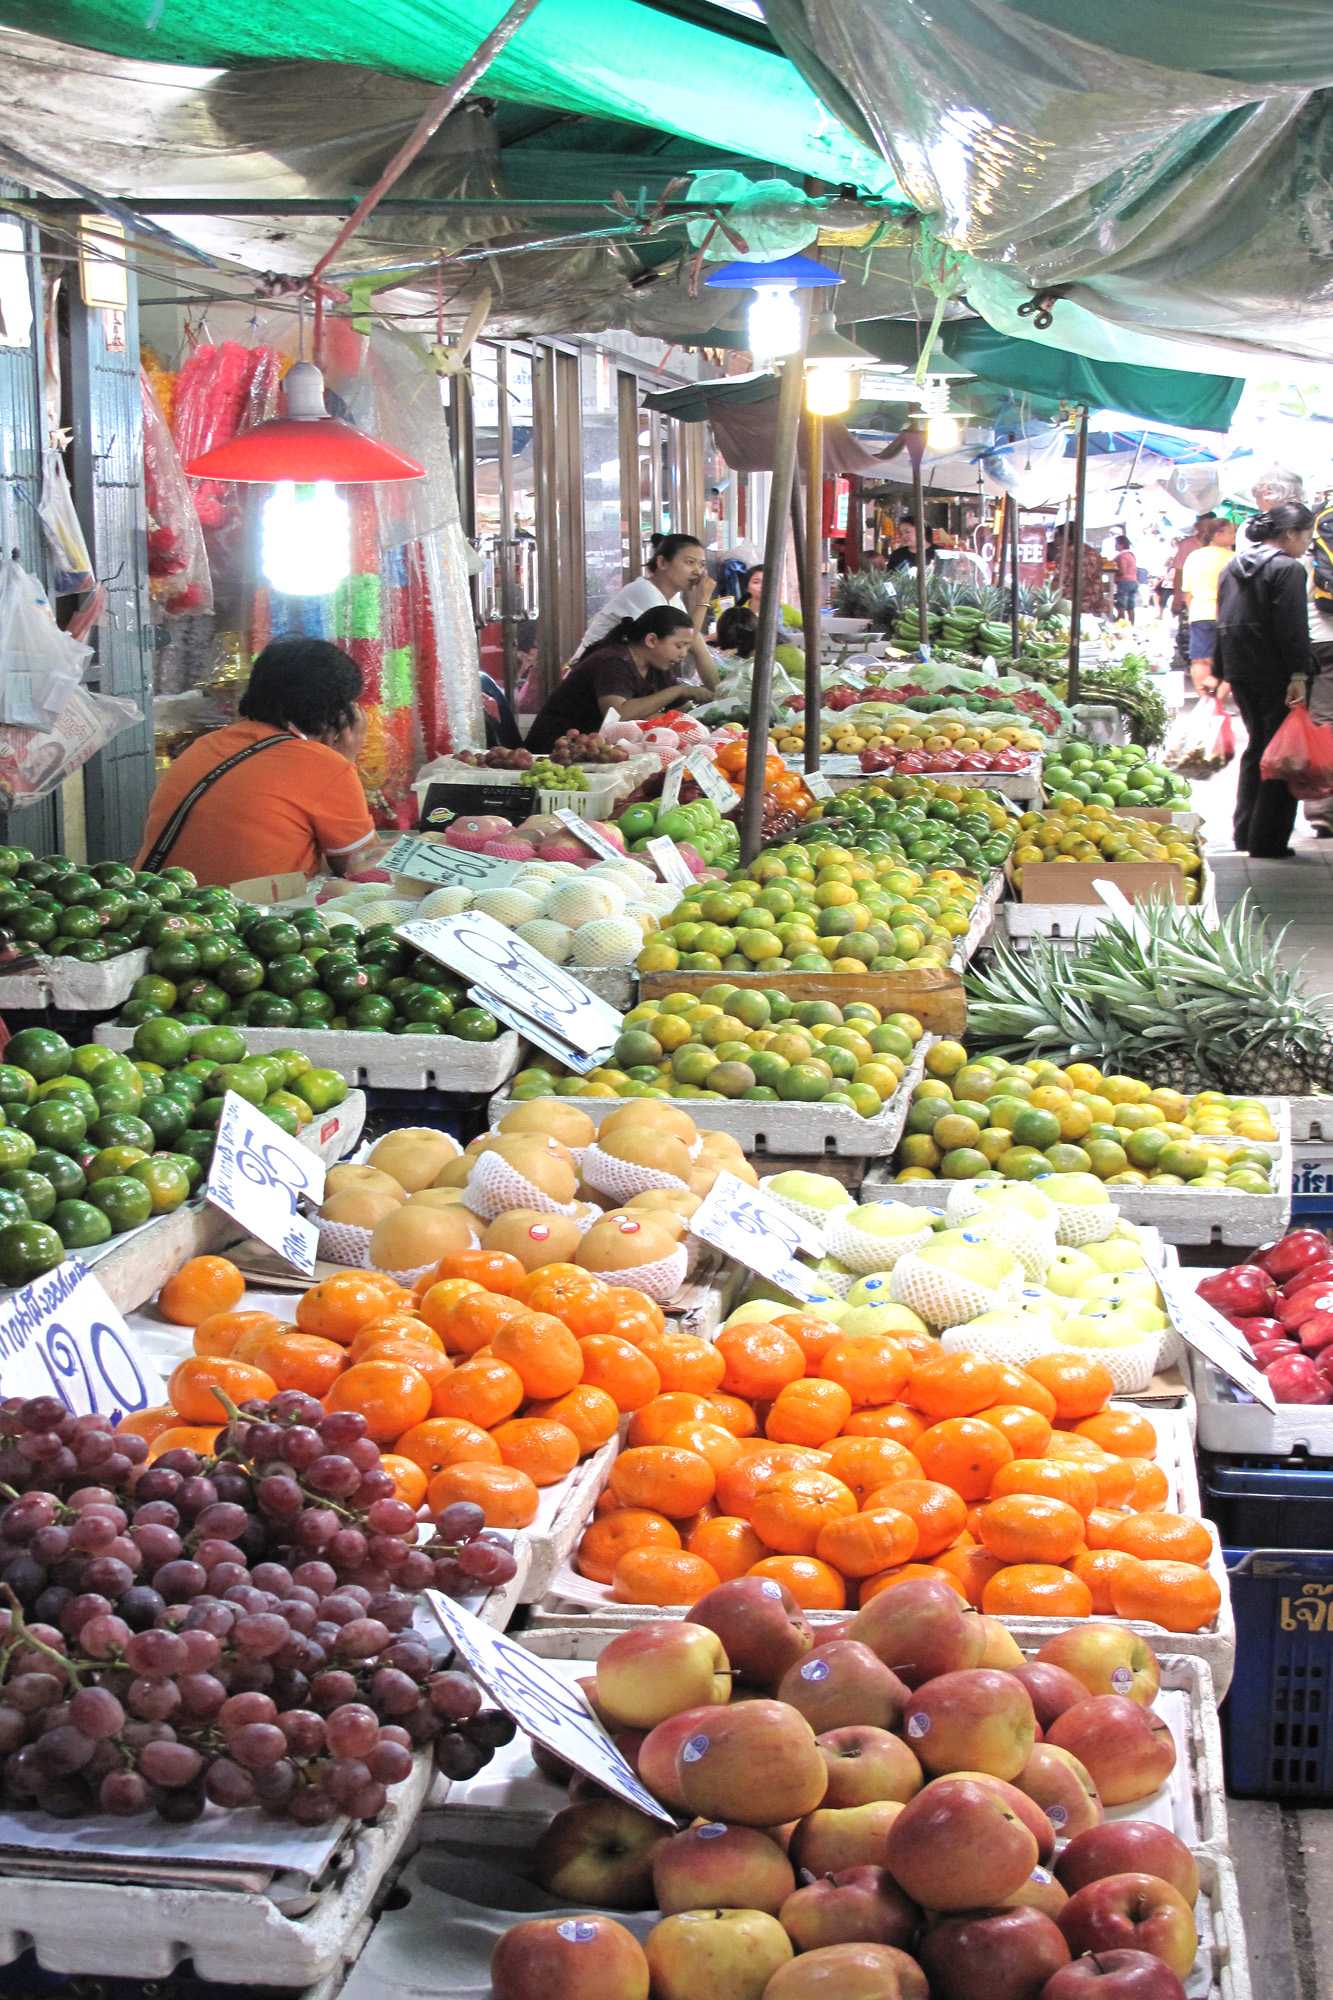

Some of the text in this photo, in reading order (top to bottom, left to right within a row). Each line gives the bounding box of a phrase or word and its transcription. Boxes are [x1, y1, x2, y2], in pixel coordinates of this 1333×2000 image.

[981, 543, 1043, 562] CFEE
[416, 844, 497, 878] 60
[453, 929, 592, 1014] 80
[236, 1129, 308, 1216] 35
